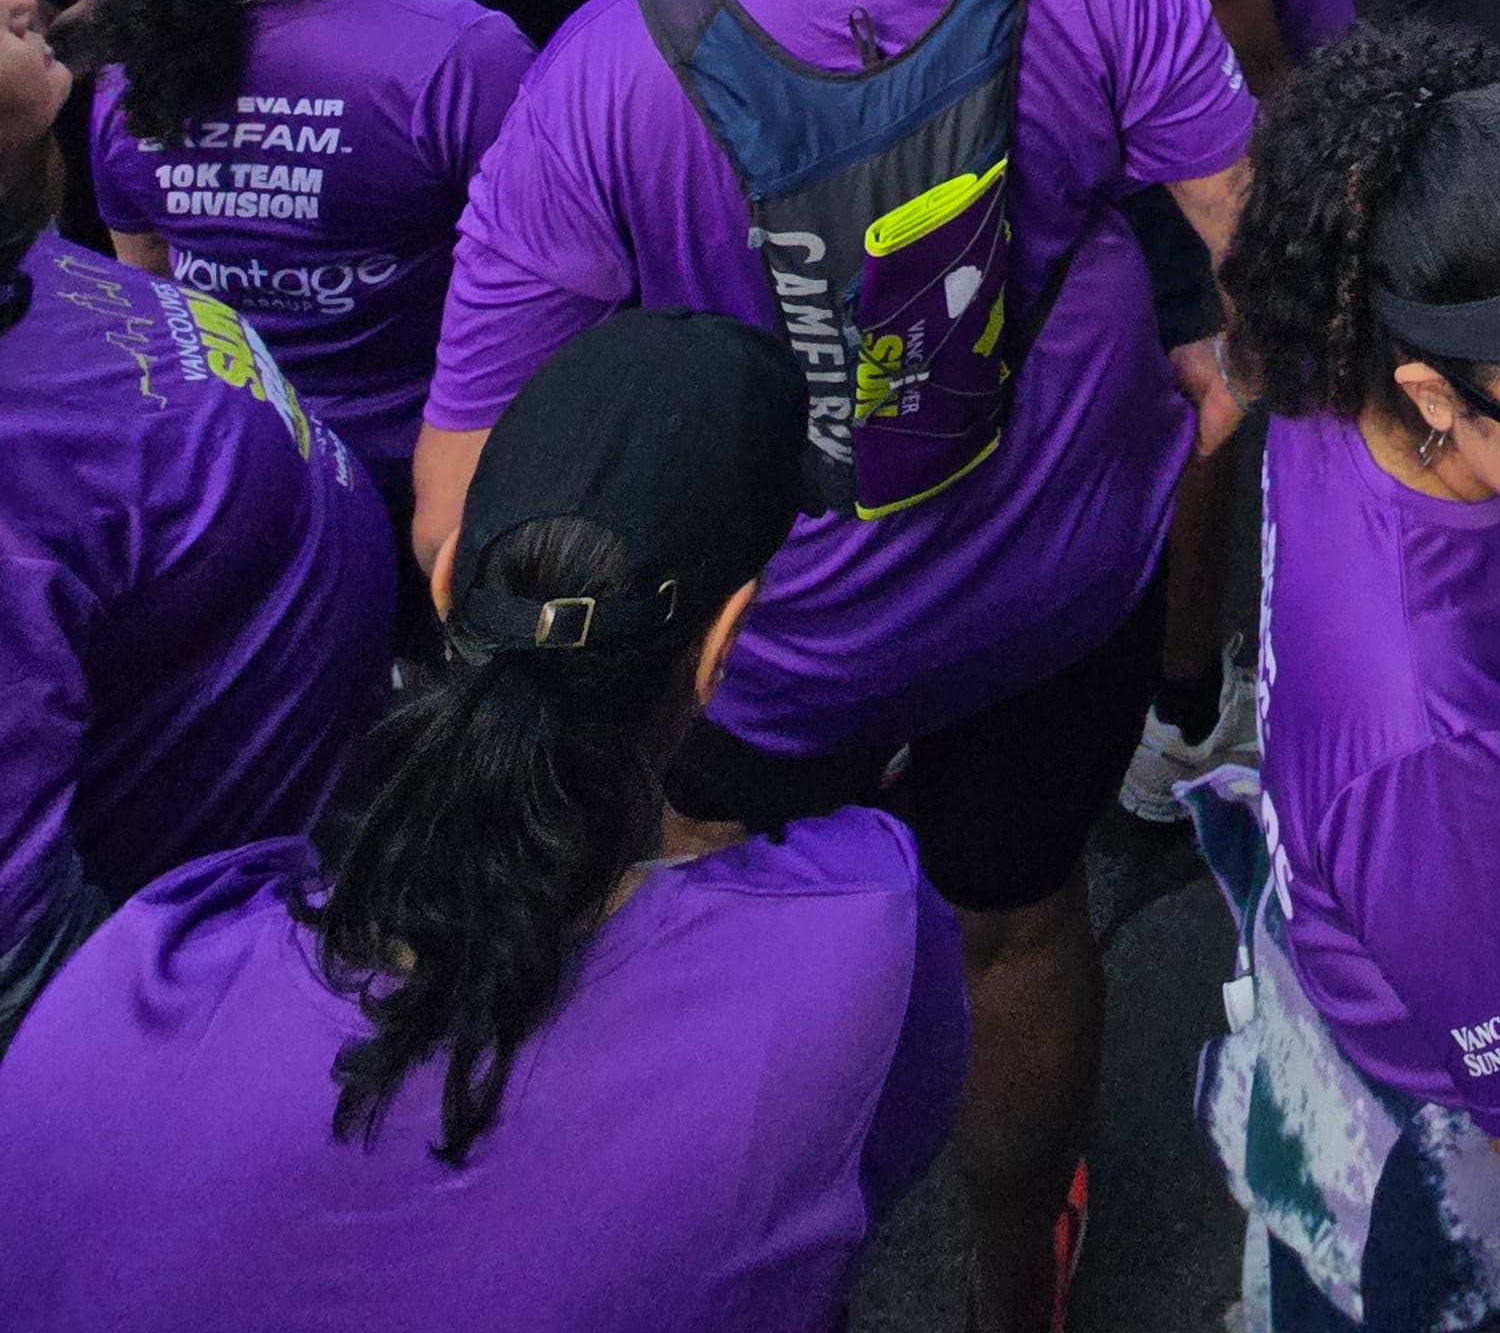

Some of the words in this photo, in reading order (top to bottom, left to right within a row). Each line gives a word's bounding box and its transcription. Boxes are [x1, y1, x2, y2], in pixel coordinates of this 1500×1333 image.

[155, 163, 222, 189] 10K
[230, 163, 323, 193] TEAM
[166, 191, 319, 219] DIVISION
[174, 251, 398, 315] Vantage
